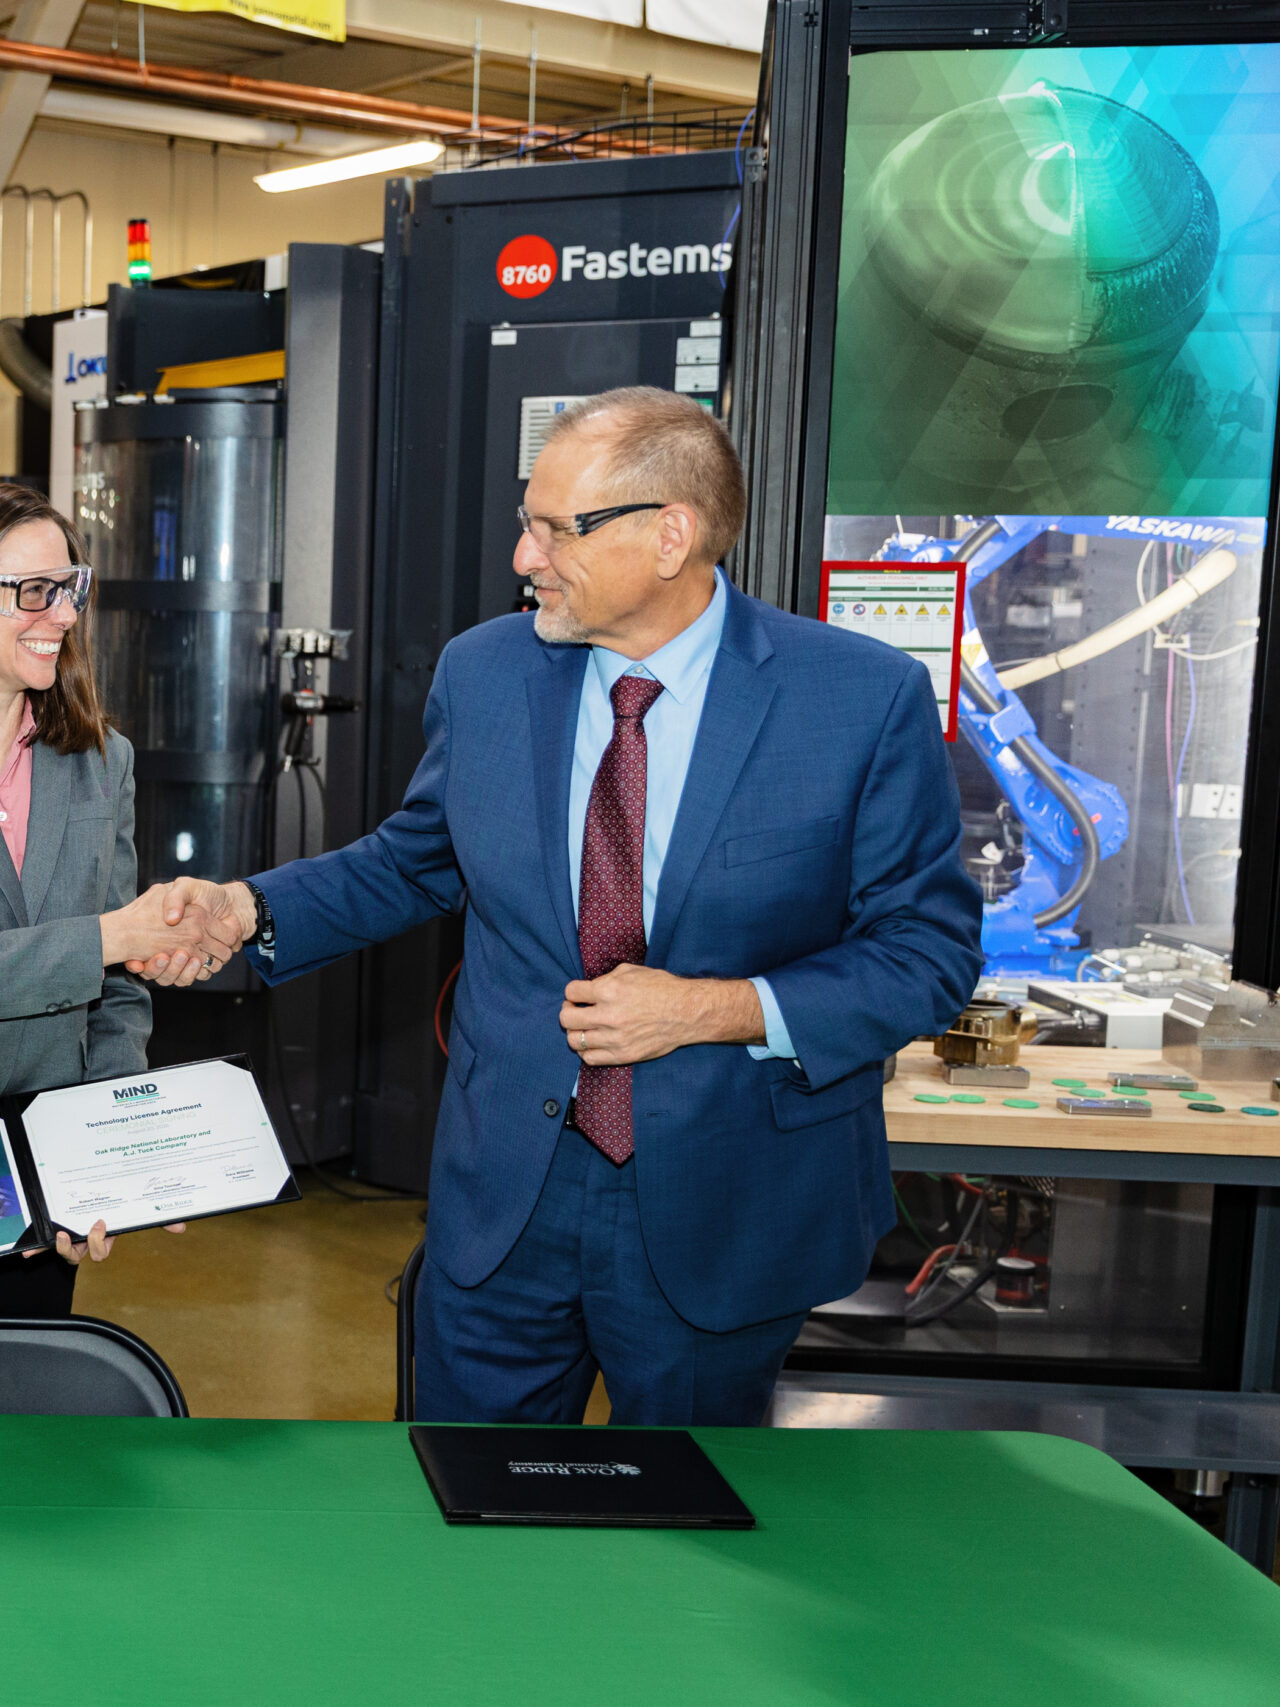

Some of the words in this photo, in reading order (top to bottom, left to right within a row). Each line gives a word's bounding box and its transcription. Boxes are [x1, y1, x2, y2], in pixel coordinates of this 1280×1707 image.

[502, 264, 551, 286] 8760
[561, 242, 732, 282] Fastems
[1105, 515, 1235, 545] YASKAWA
[85, 1116, 129, 1128] Technology
[130, 1111, 159, 1121] License
[161, 1102, 202, 1115] Agreement
[109, 1144, 129, 1154] Ridge
[131, 1139, 159, 1149] National
[160, 1133, 197, 1144] Laboratory
[138, 1146, 153, 1154] Tuck
[155, 1141, 187, 1151] Company
[508, 1466, 572, 1475] RIDGE
[575, 1467, 616, 1476] OAK
